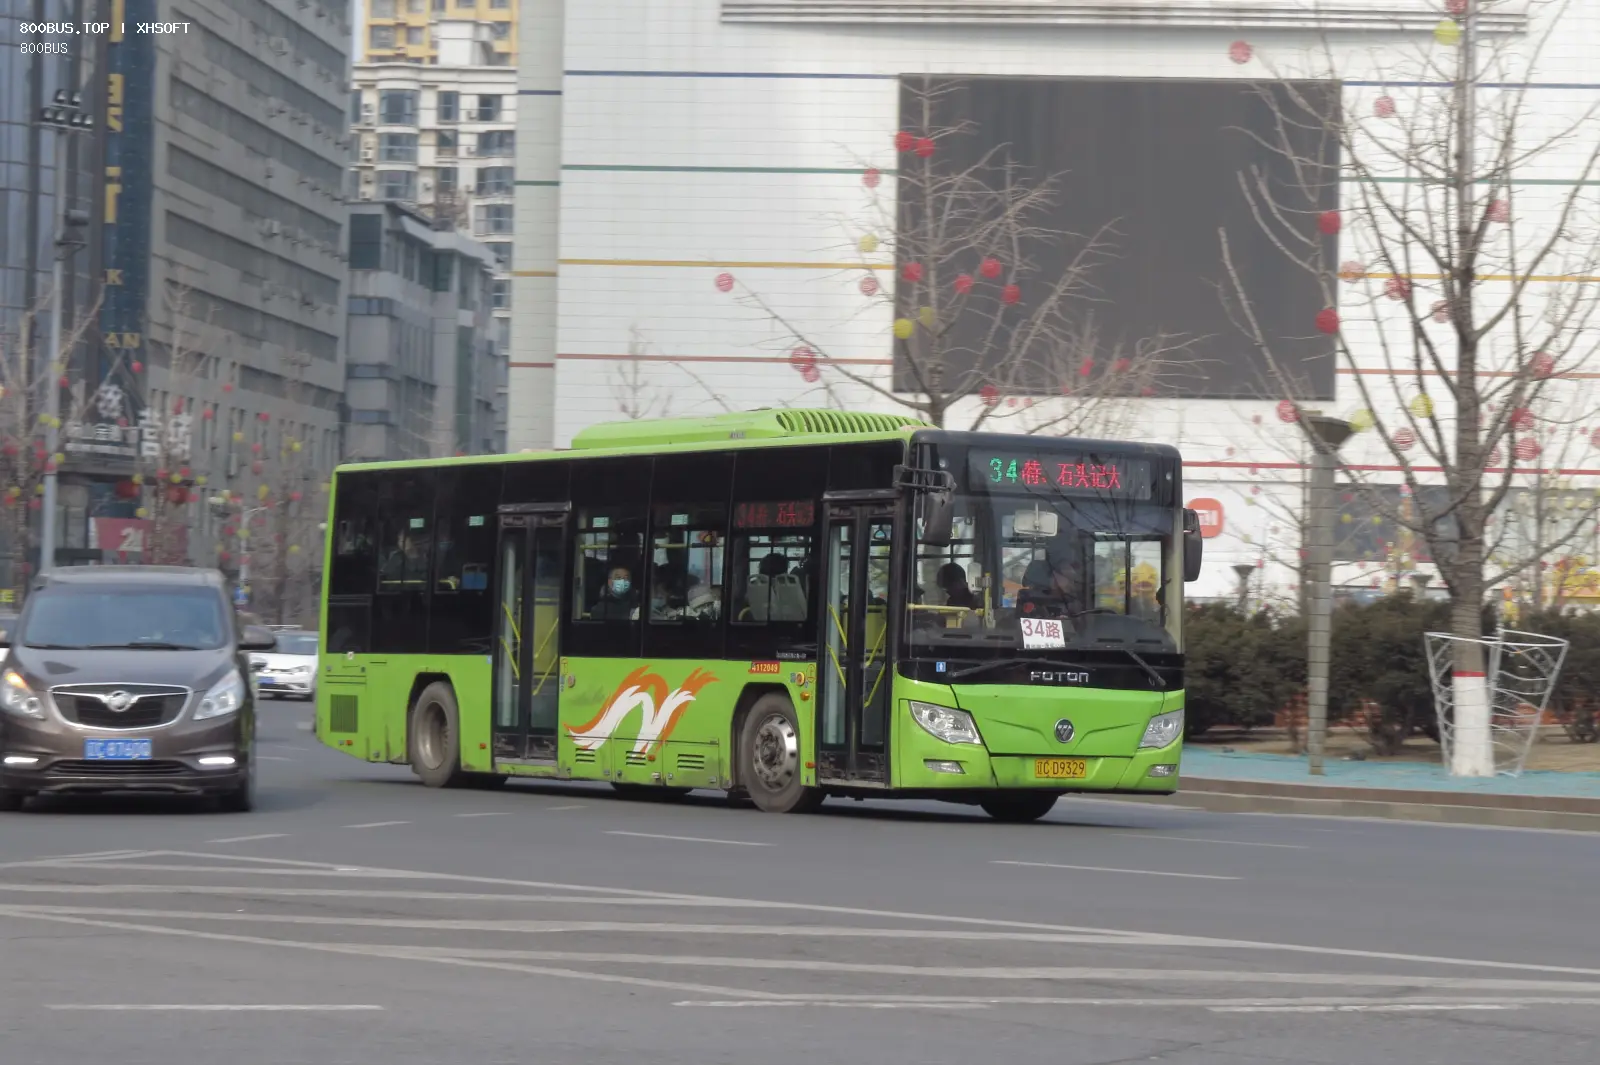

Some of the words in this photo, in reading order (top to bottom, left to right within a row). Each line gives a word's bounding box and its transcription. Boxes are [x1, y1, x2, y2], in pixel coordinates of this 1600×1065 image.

[989, 457, 1018, 484] 34
[1022, 618, 1060, 639] 34路
[1030, 671, 1089, 683] FOTON
